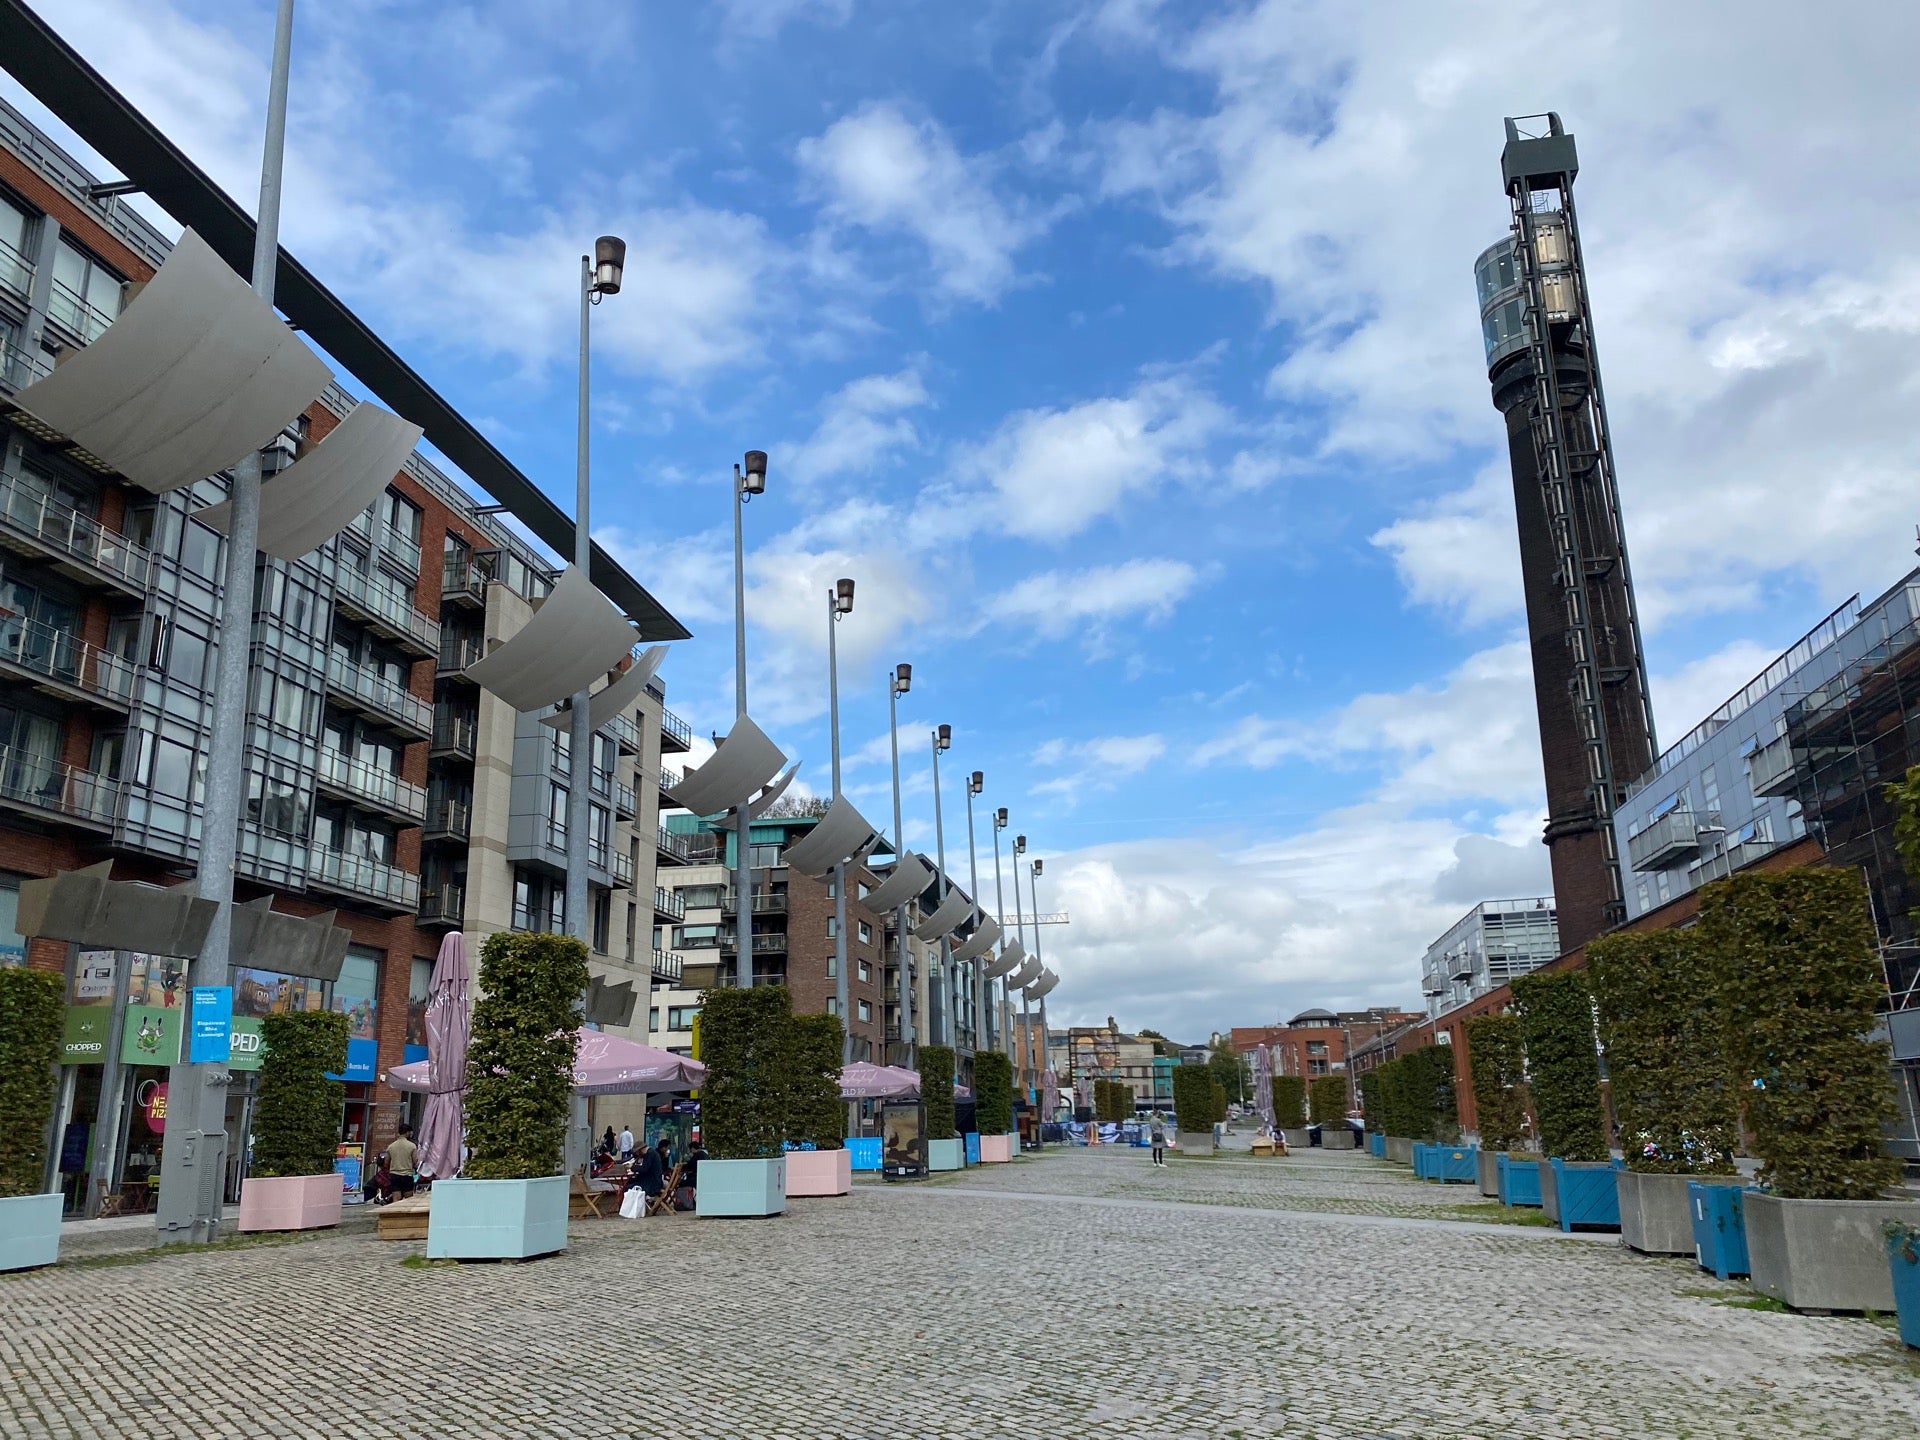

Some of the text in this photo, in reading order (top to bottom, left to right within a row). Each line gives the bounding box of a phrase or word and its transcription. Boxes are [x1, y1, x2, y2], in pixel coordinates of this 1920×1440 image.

[65, 1043, 101, 1051] CHOPPED
[229, 1032, 260, 1052] PED
[152, 1096, 168, 1108] NE
[151, 1108, 167, 1118] PIZ
